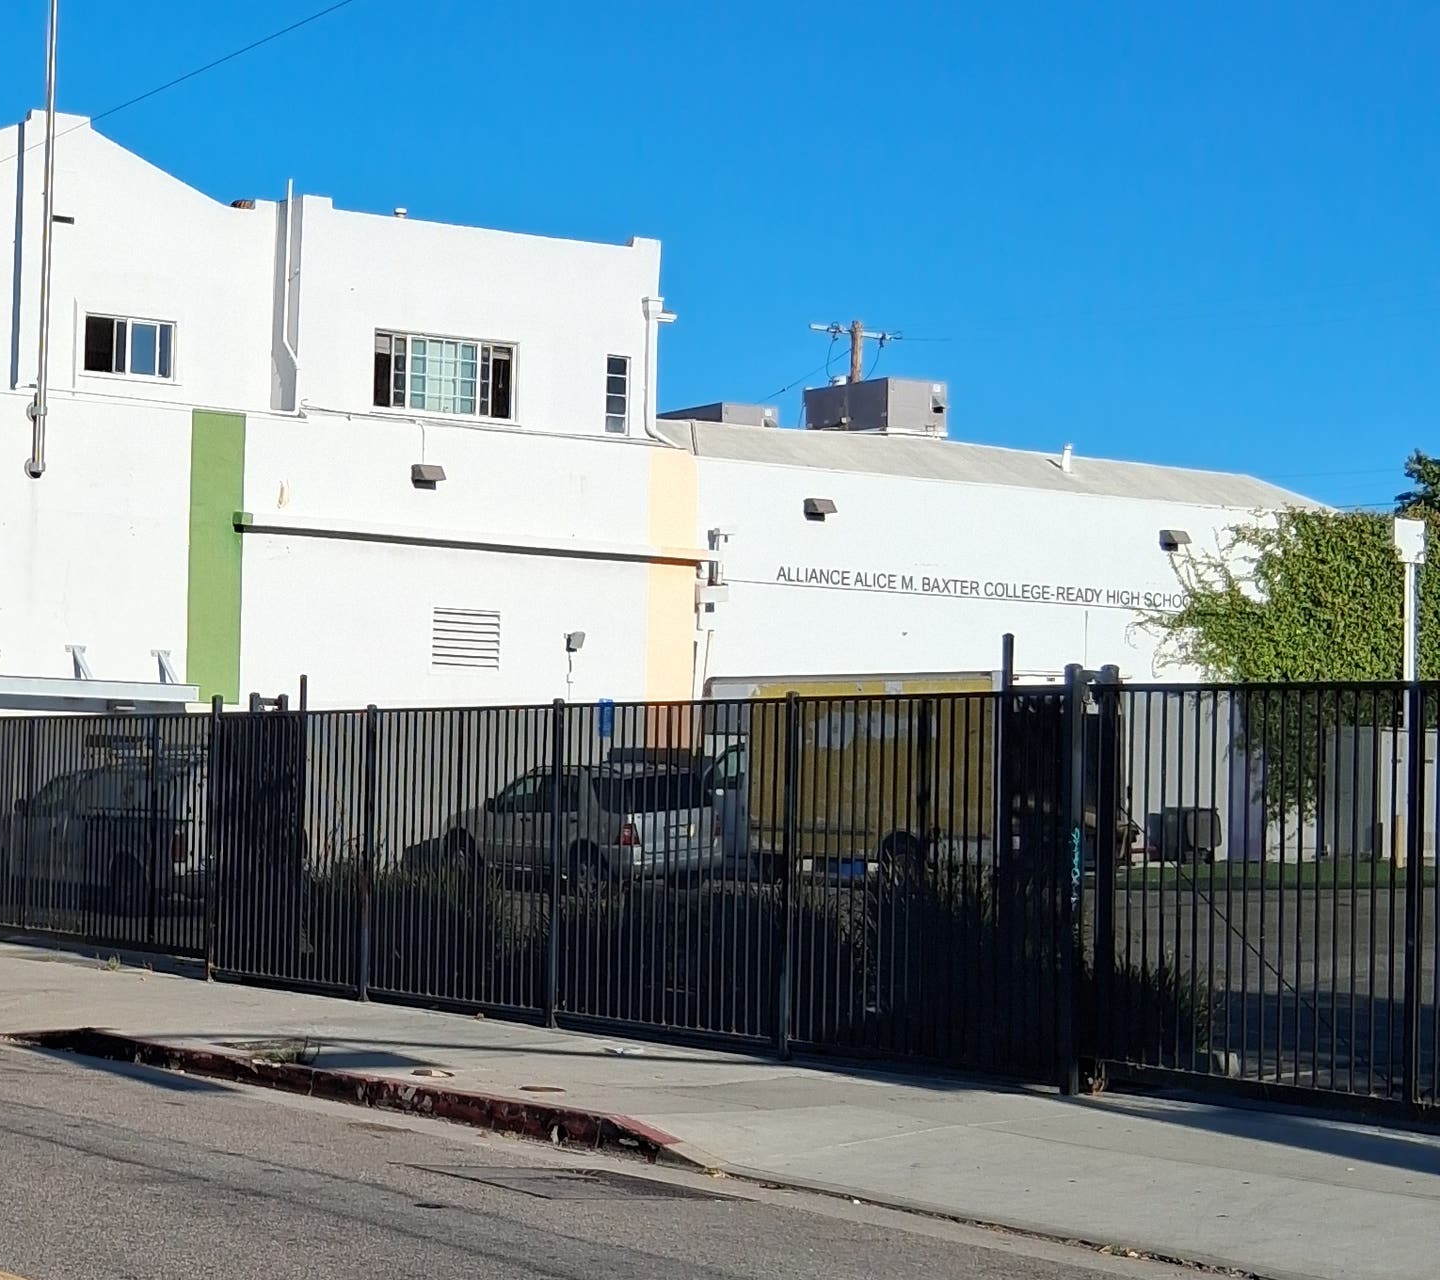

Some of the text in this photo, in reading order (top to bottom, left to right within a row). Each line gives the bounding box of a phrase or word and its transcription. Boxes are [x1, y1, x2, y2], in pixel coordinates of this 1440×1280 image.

[776, 566, 851, 586] ALLIANCE
[854, 571, 897, 590] ALICE
[901, 575, 918, 591] M.
[921, 577, 980, 596] BAXTER
[984, 582, 1103, 604] COLLEGE-READY
[1106, 590, 1141, 606] HIGH
